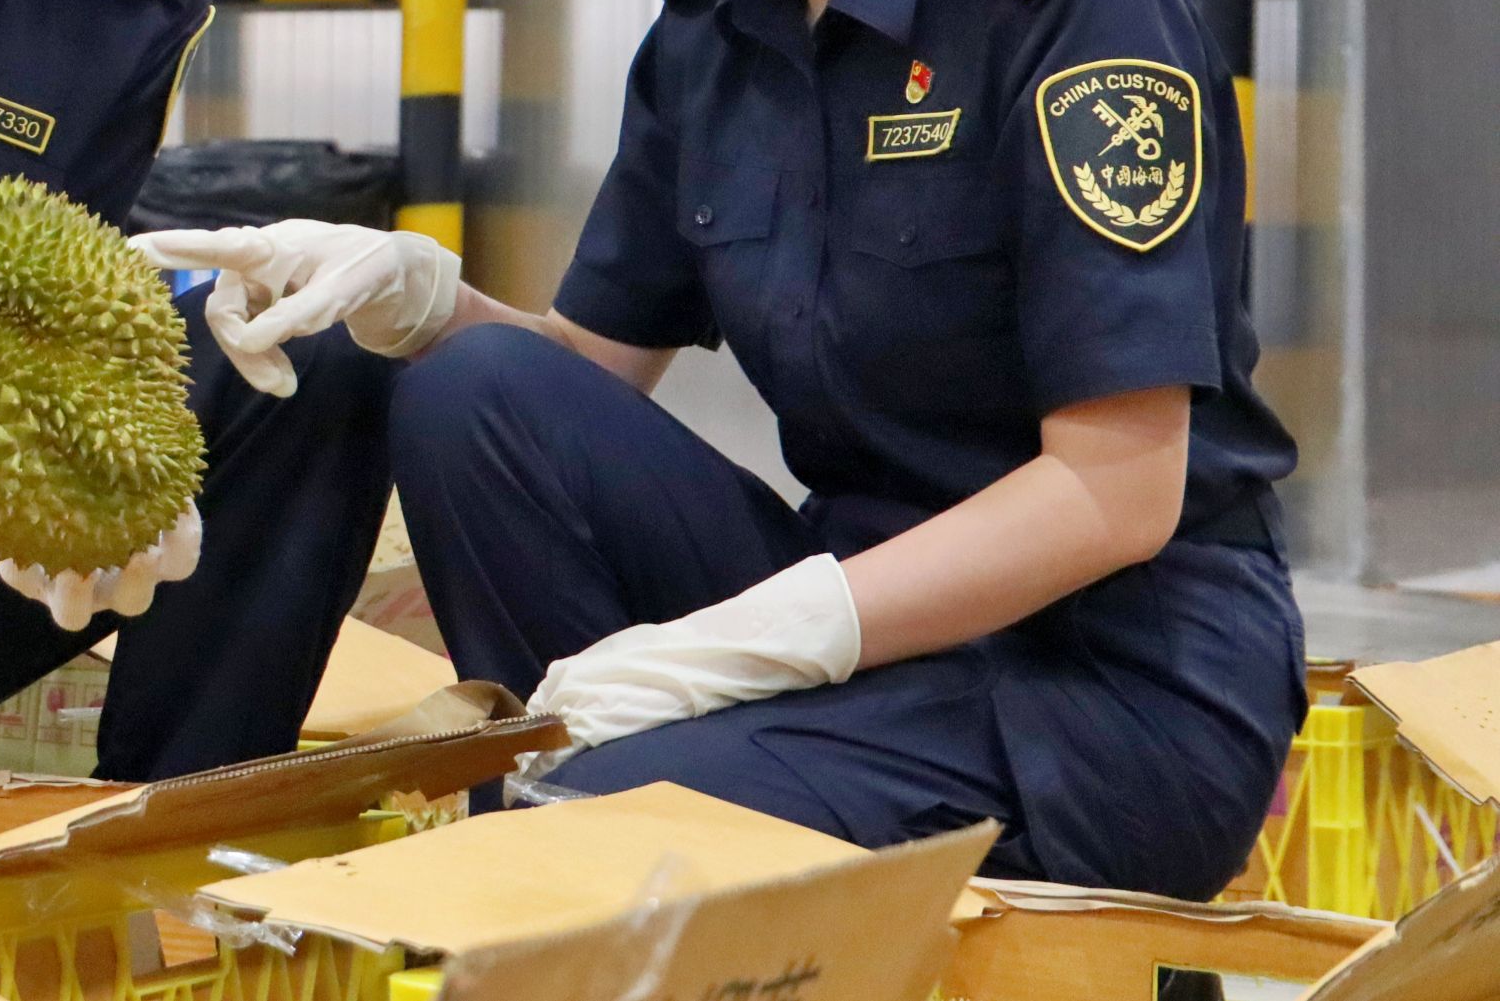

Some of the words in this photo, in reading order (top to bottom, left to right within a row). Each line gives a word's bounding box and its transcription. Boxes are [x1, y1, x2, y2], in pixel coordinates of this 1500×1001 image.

[1050, 77, 1103, 116] CHINA
[1106, 74, 1190, 112] CUSTOMS
[882, 122, 950, 147] 7237540
